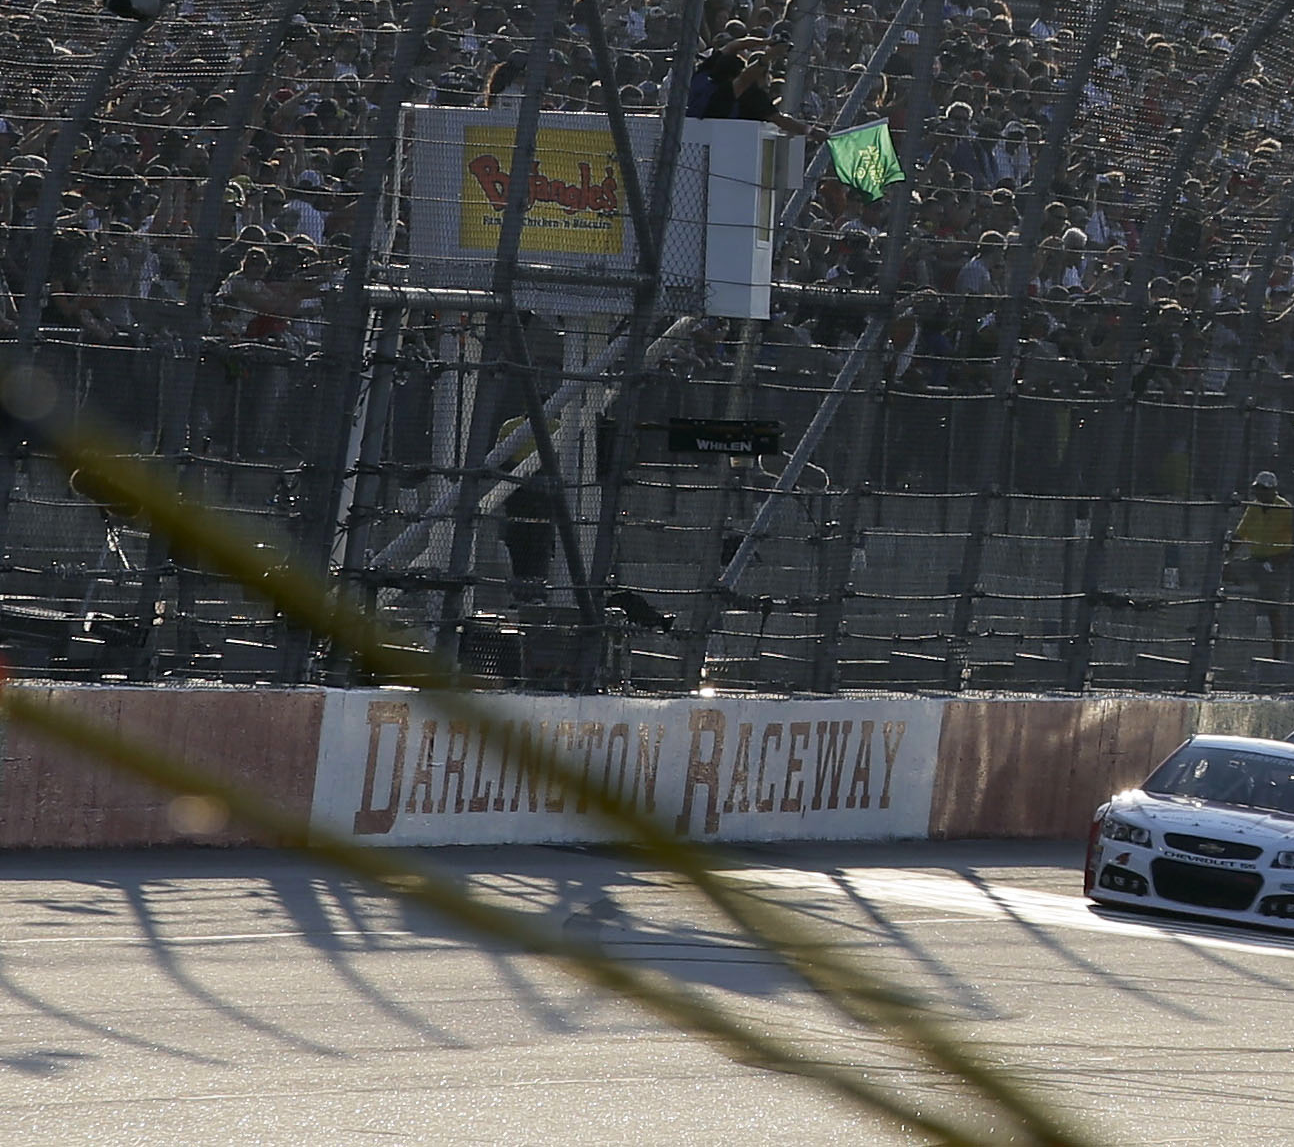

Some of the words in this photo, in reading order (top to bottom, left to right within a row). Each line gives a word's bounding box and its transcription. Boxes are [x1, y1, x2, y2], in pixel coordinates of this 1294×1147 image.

[696, 438, 752, 452] WHELEN
[353, 700, 664, 835] DARLINGTON
[676, 708, 906, 835] RACEWAY
[1164, 850, 1236, 868] CHEVROLET
